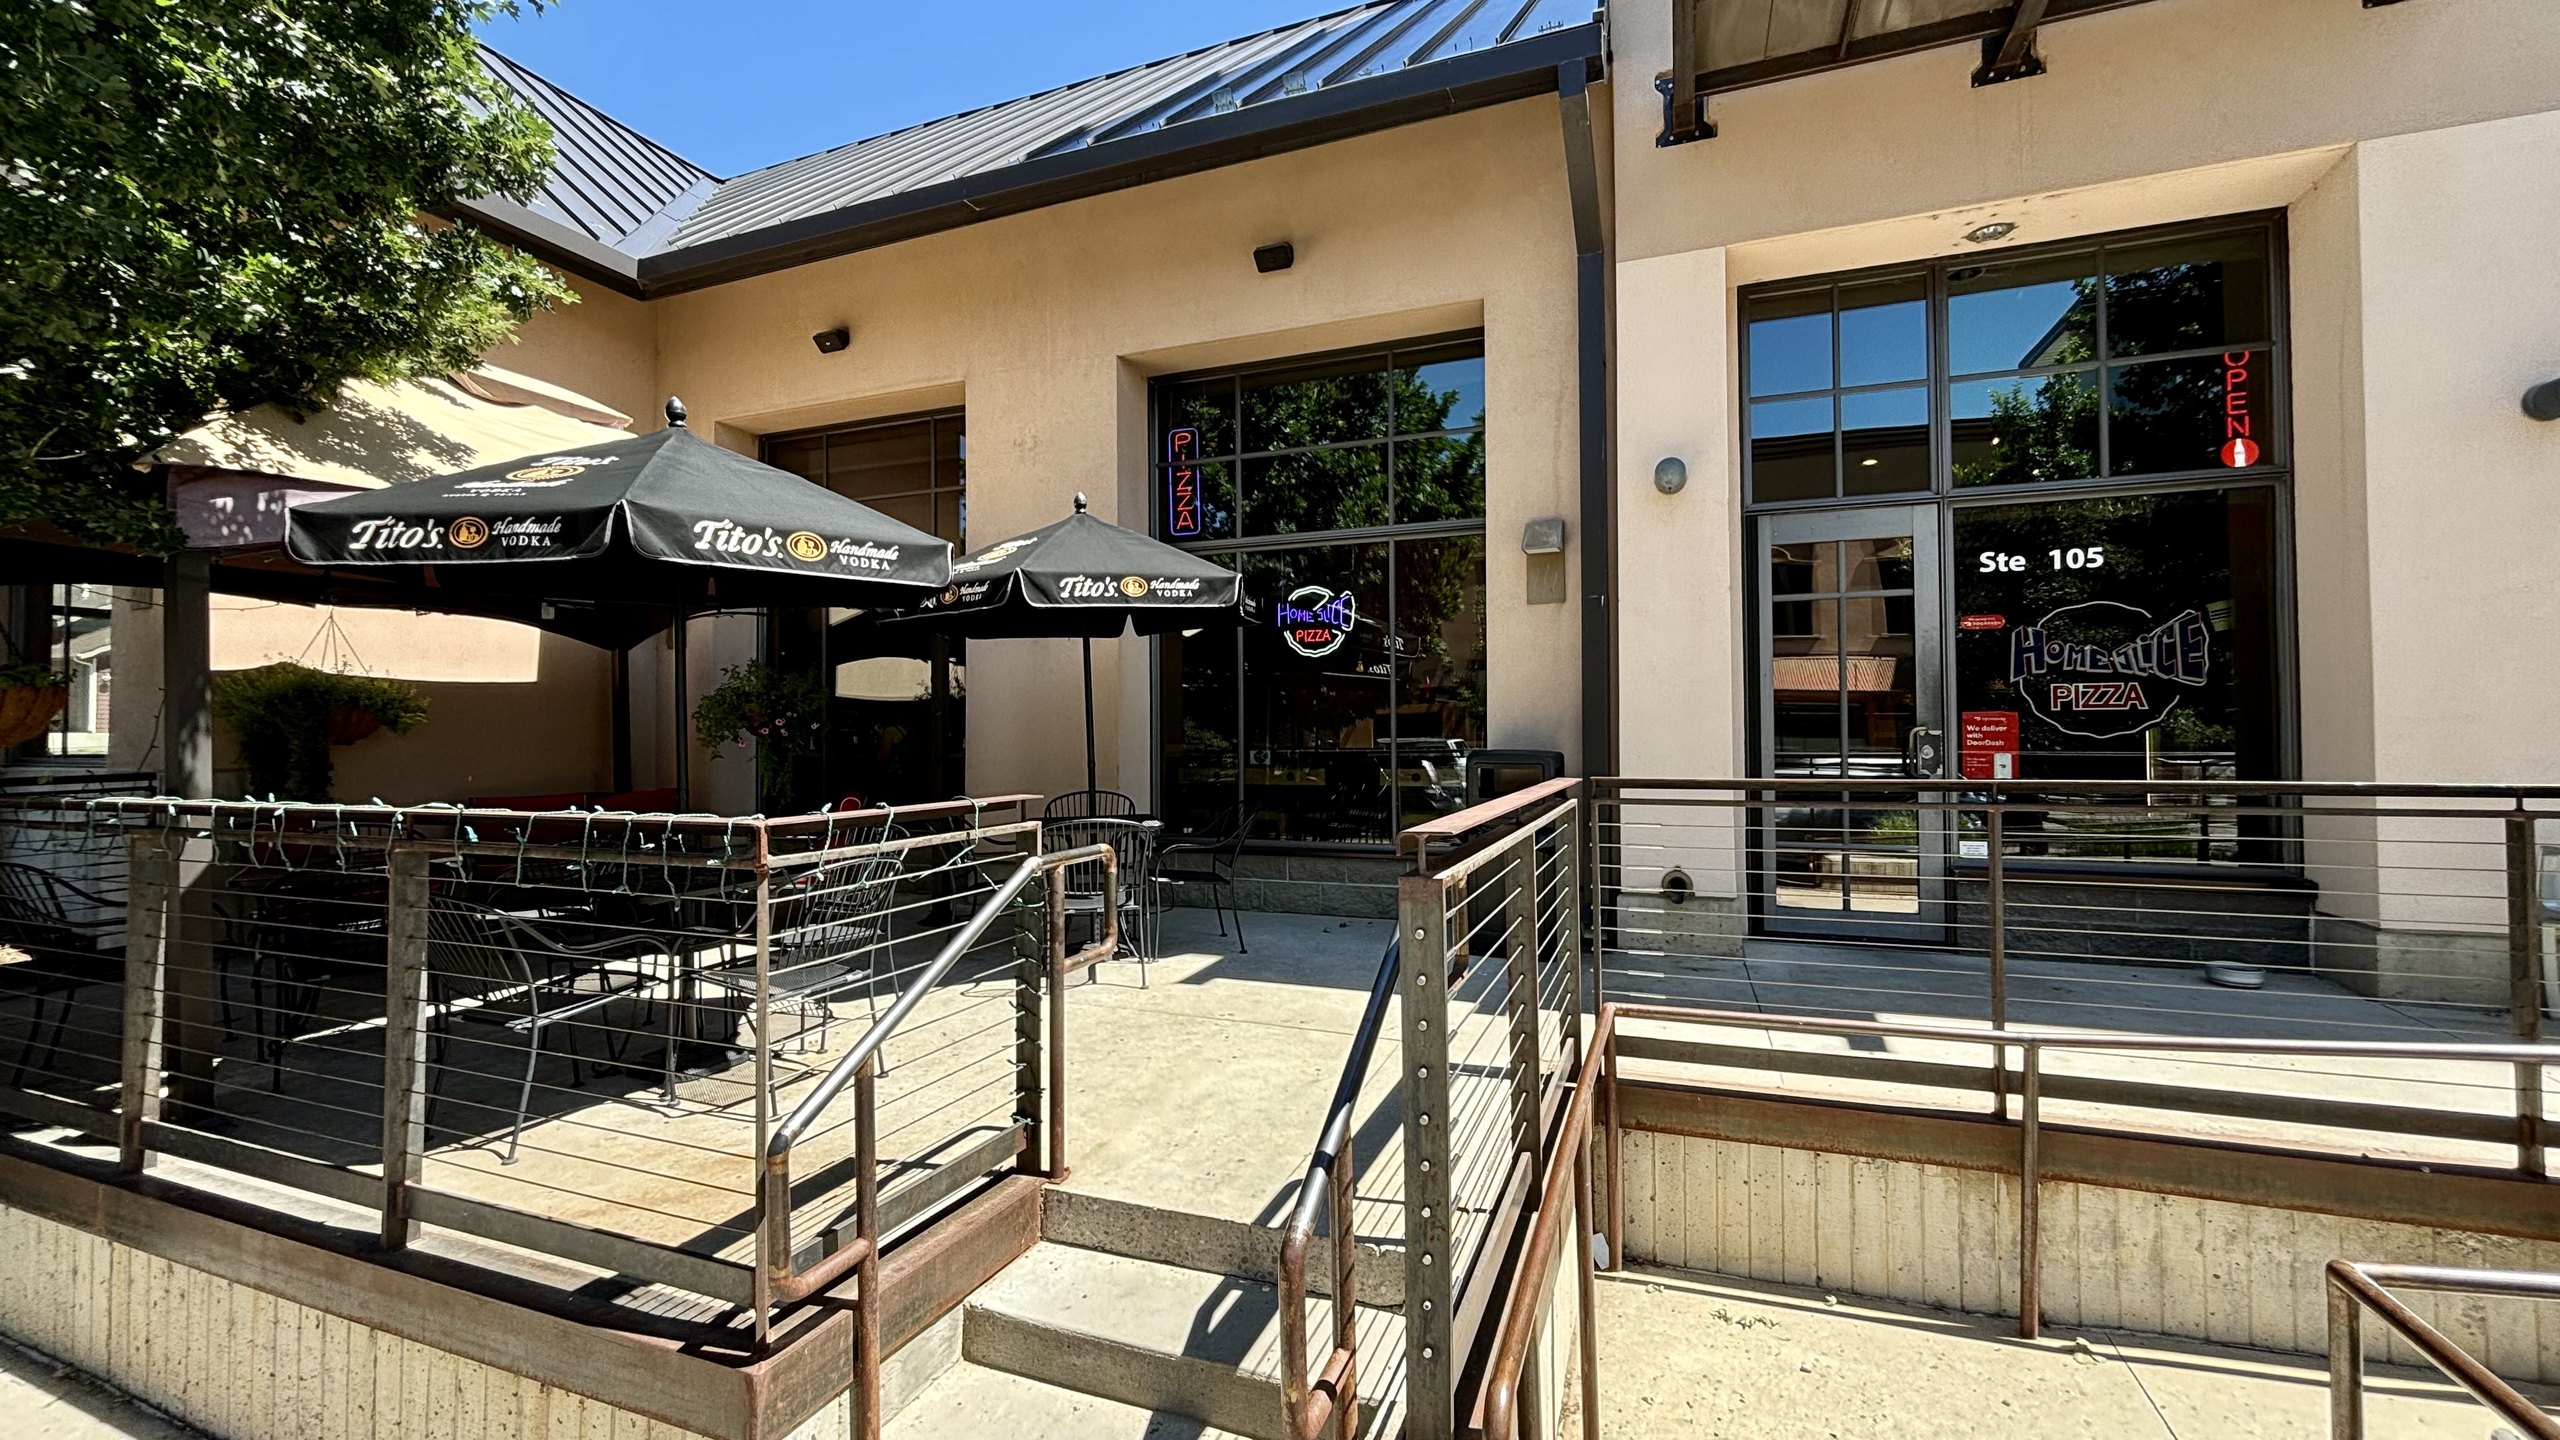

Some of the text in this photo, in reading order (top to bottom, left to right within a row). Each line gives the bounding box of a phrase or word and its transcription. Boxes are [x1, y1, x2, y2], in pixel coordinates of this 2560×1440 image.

[1175, 432, 1194, 530] PIZZA
[491, 516, 562, 536] Handmade
[501, 534, 552, 548] VODKA
[830, 538, 900, 561] Handmade
[839, 554, 891, 571] VODKA
[1979, 547, 2105, 573] Ste 105
[1156, 589, 1194, 597] VODKA
[1277, 603, 1315, 628] HOME
[1296, 628, 1332, 643] PIZZA
[2010, 625, 2114, 683] HOME
[2051, 682, 2149, 711] PIZZA
